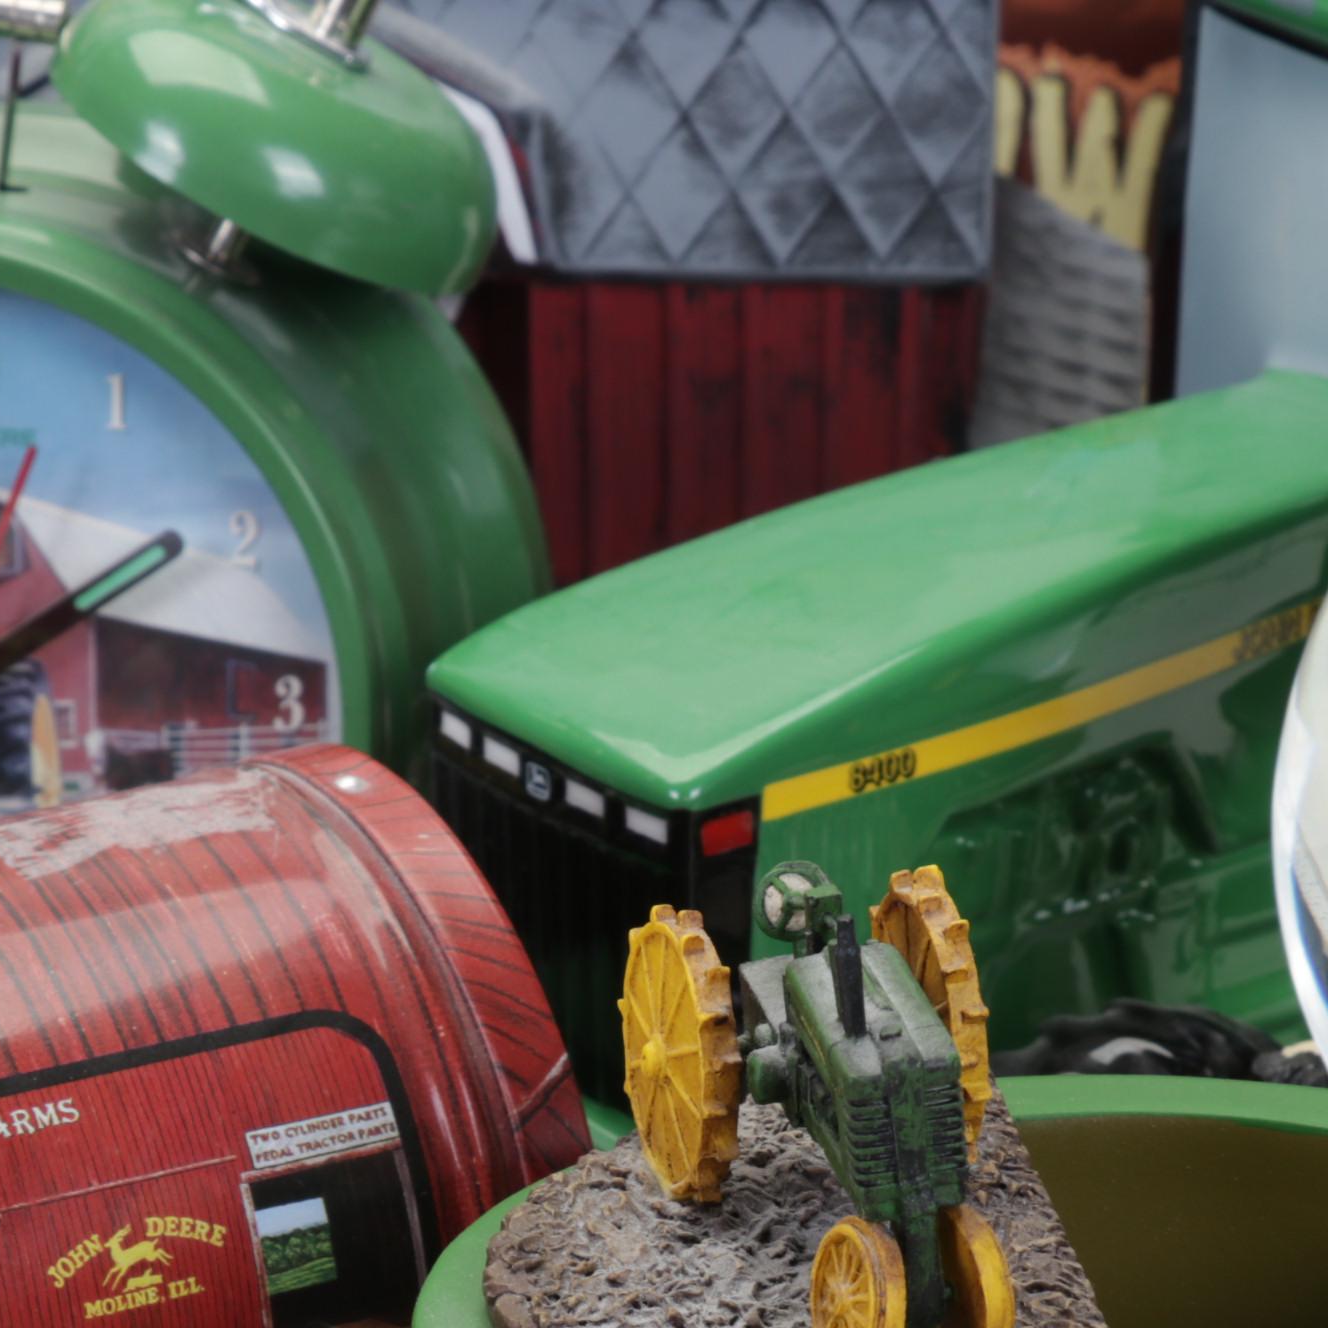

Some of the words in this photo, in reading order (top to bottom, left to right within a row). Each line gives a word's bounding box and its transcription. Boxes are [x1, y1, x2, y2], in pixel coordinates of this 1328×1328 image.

[105, 372, 128, 431] 1
[229, 509, 261, 570] 2
[272, 674, 306, 733] 3
[250, 1132, 281, 1146] TWO
[284, 1115, 345, 1139] CYLINDER
[347, 1106, 388, 1124] PARTS
[255, 1146, 295, 1164] PEDAL
[296, 1131, 357, 1154] TRACTOR
[357, 1122, 397, 1140] PARTS
[47, 1233, 104, 1289] JOHN
[145, 1215, 227, 1248] DEERE
[83, 1286, 167, 1320] MOLINE,
[167, 1276, 206, 1299] ILL.
